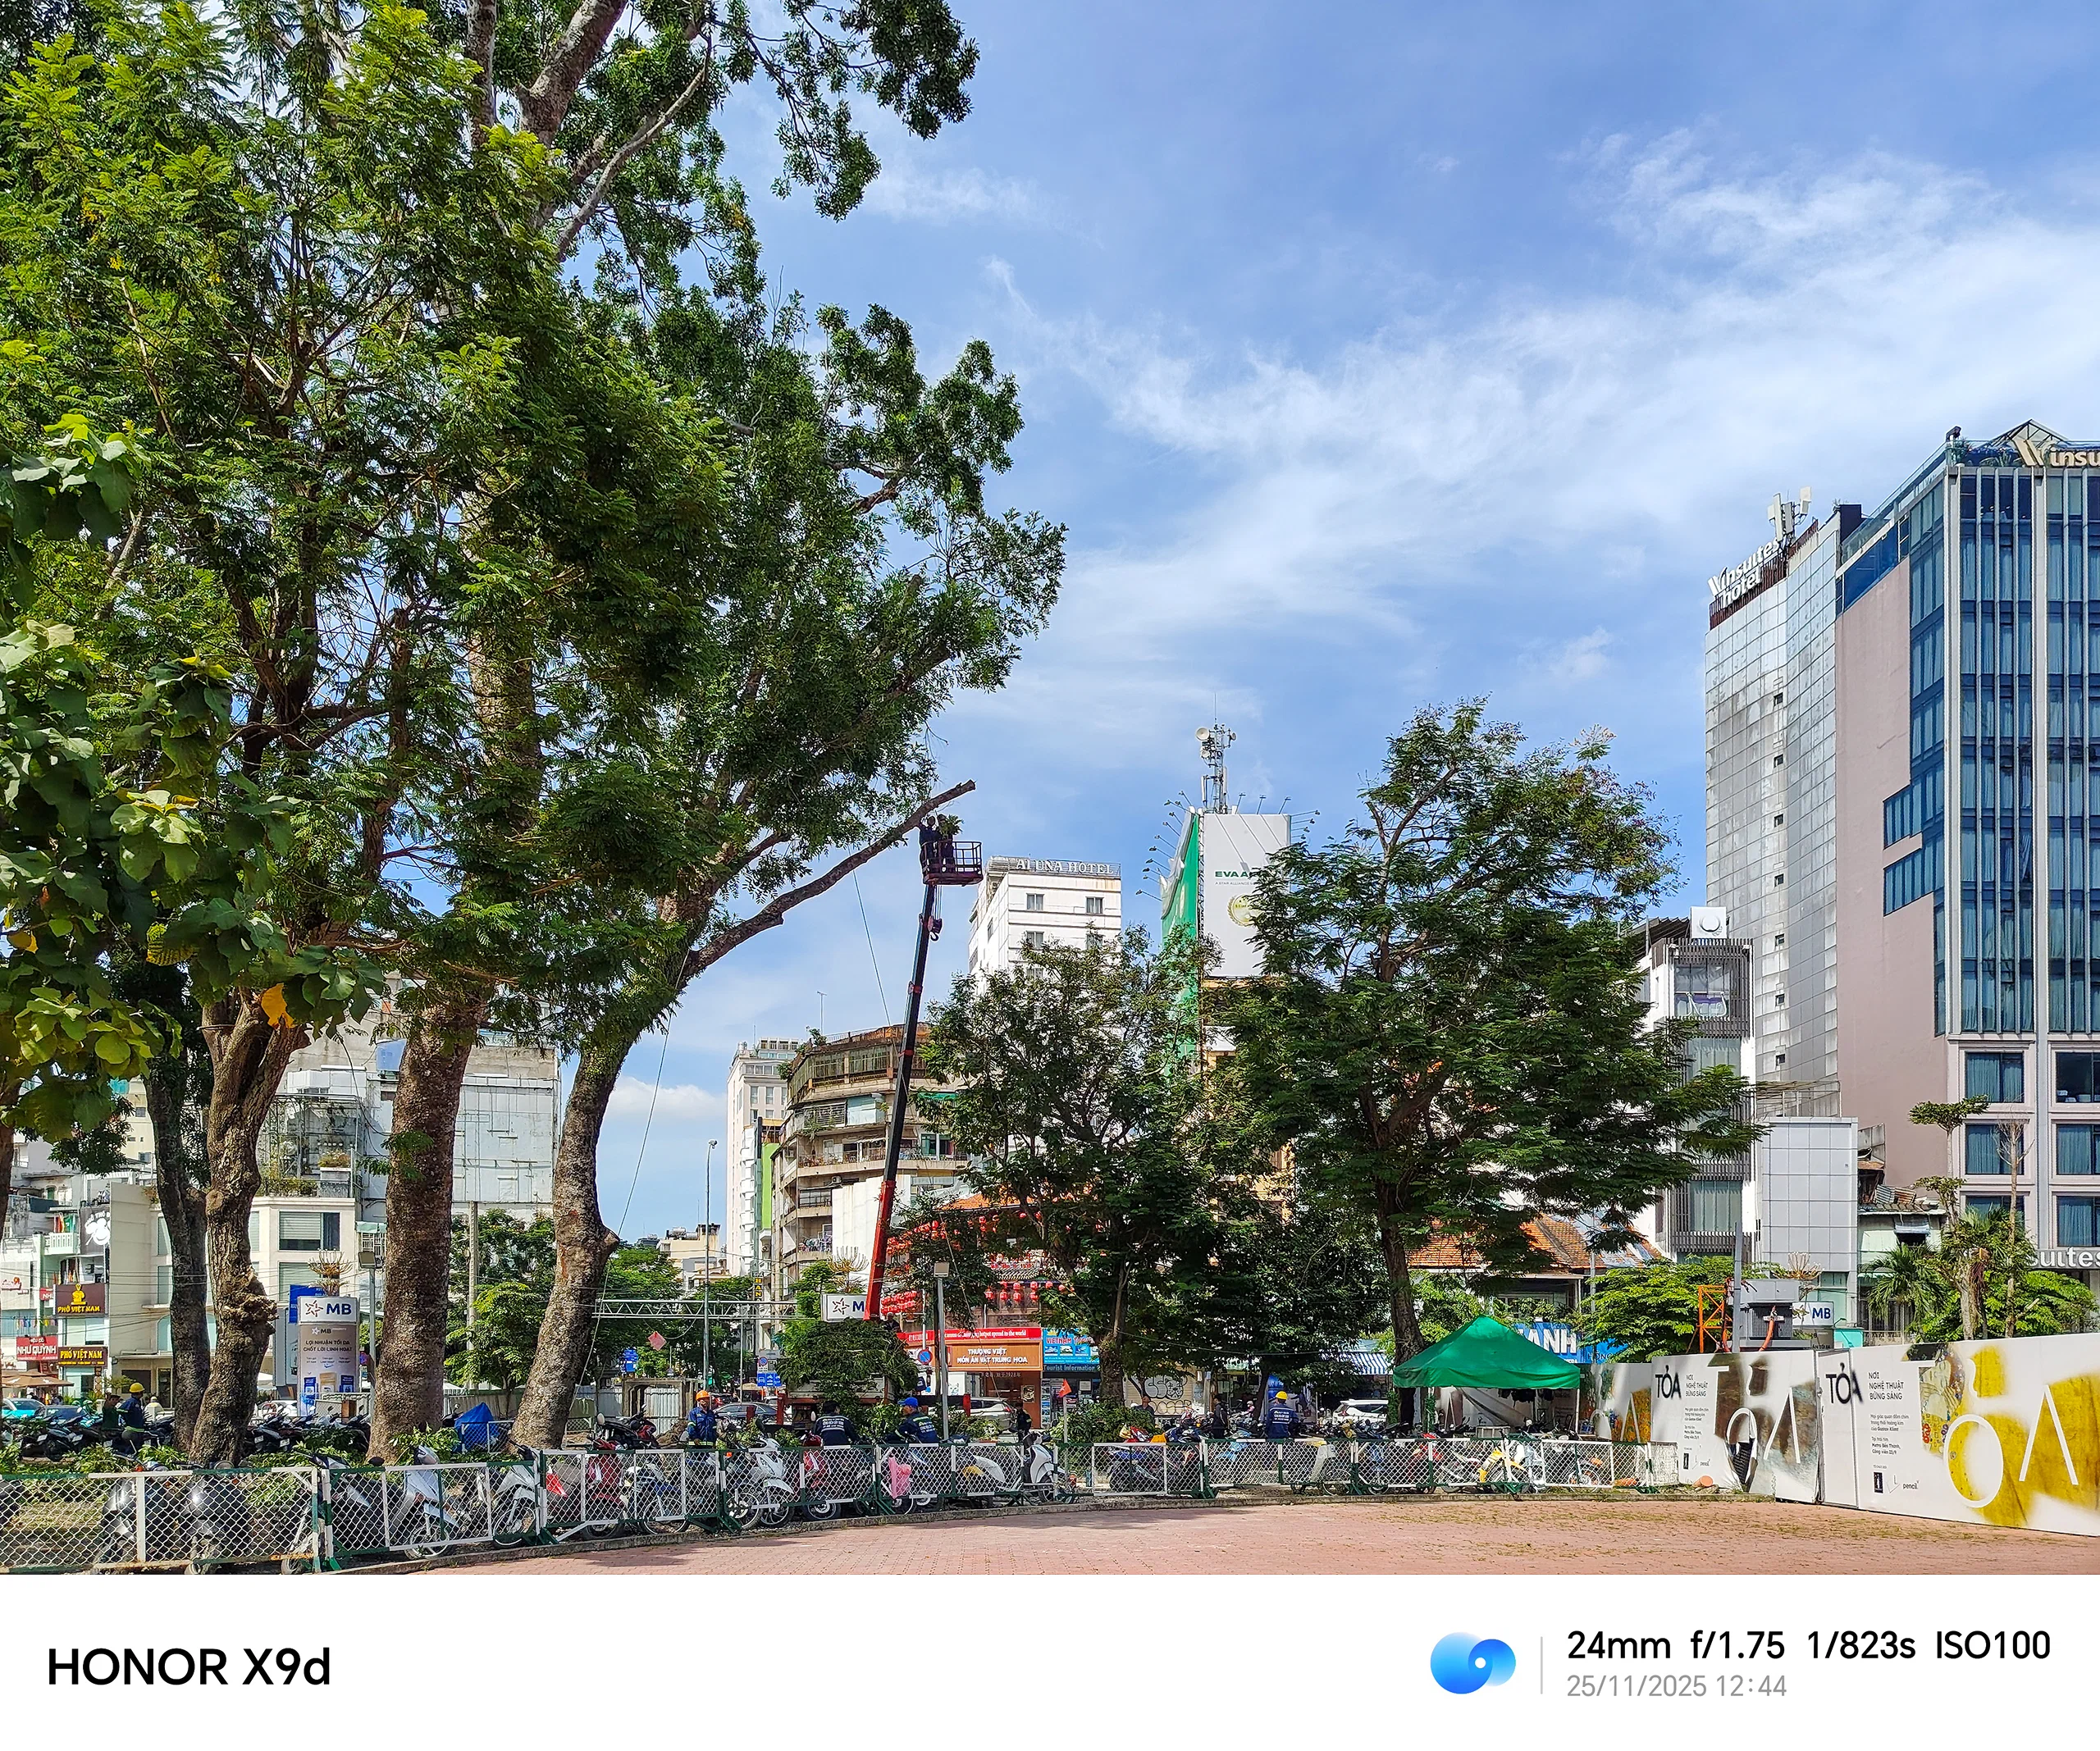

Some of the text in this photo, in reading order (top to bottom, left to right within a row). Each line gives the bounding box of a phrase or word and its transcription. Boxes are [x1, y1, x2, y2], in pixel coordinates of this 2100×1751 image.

[1068, 861, 1114, 875] HOTEL
[326, 1303, 352, 1316] MB
[1812, 1307, 1831, 1319] MB
[32, 1343, 57, 1356] QUỲNH
[88, 1350, 103, 1359] NAM
[993, 1347, 1007, 1357] VIỆT
[1869, 1371, 1879, 1379] NƠI
[1655, 1365, 1682, 1399] TỎA
[1825, 1362, 1864, 1404] TỎA
[1869, 1379, 1904, 1392] NGHỆ THUẬT
[1869, 1391, 1903, 1400] BỪNG SÁNG
